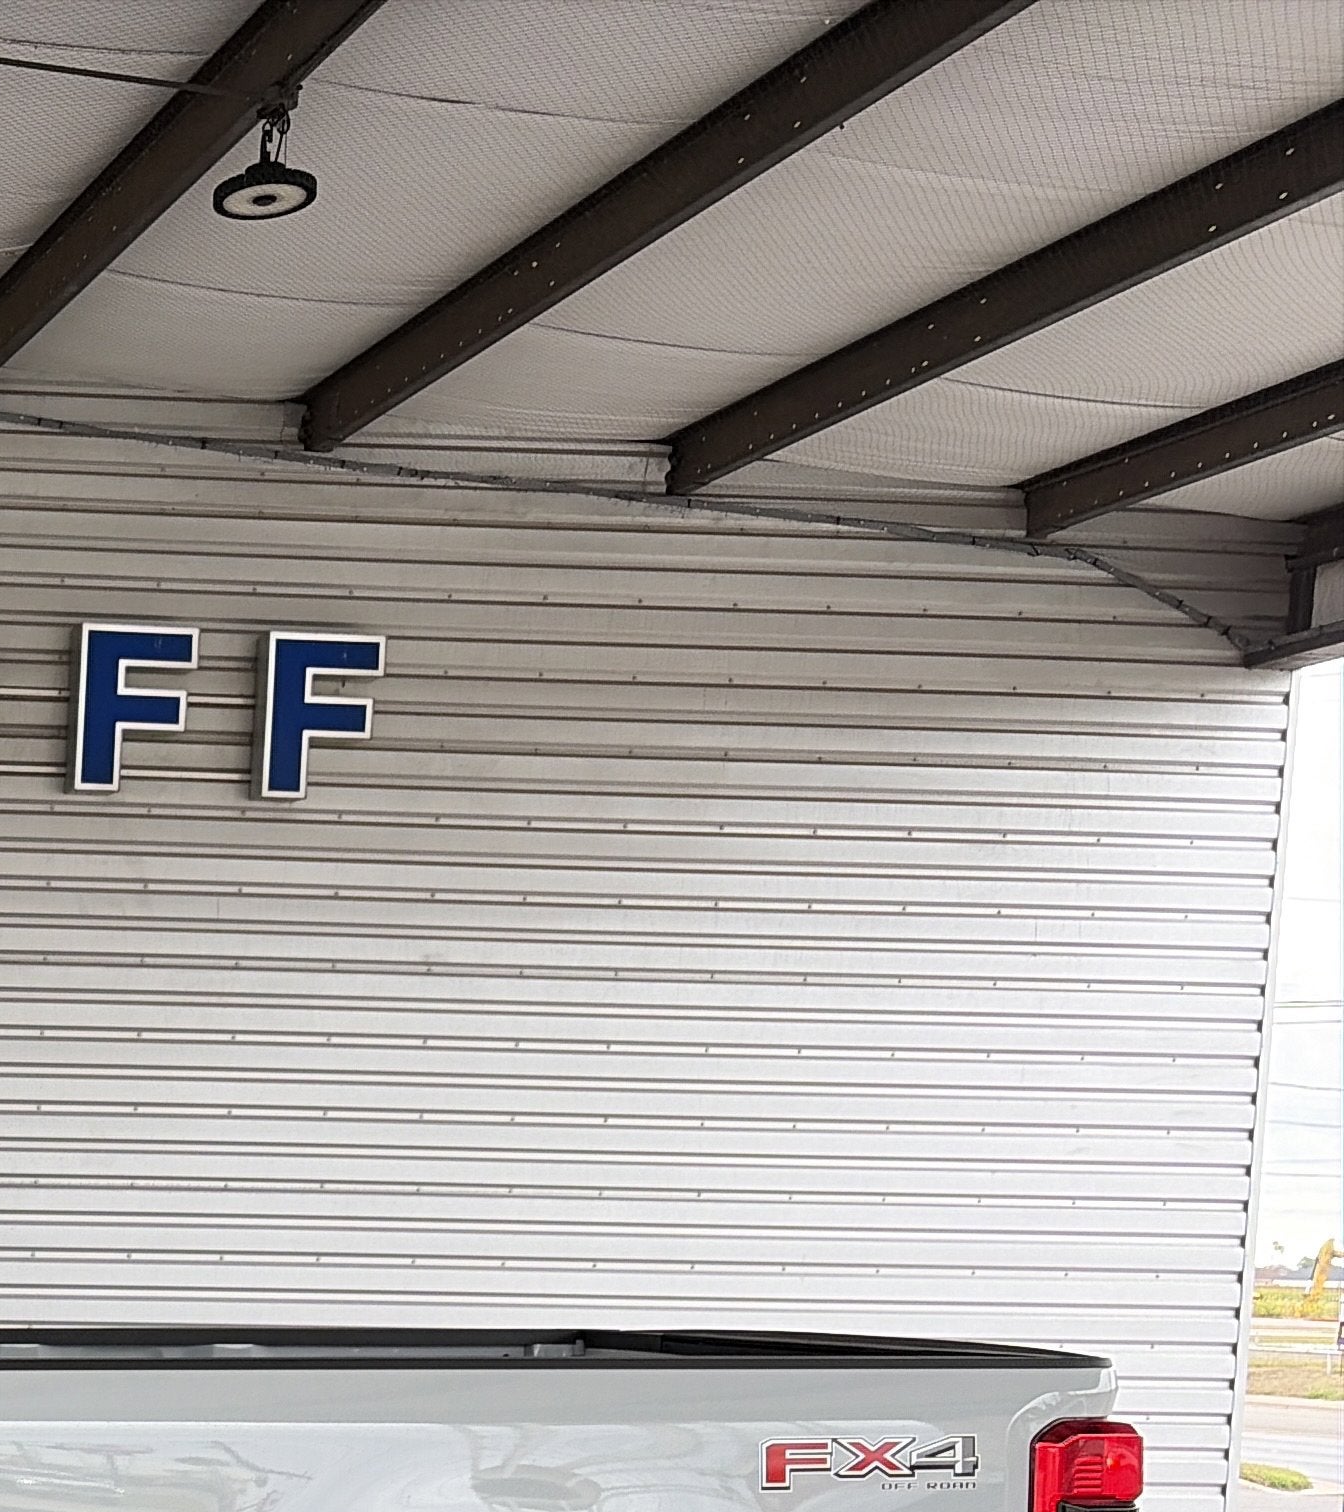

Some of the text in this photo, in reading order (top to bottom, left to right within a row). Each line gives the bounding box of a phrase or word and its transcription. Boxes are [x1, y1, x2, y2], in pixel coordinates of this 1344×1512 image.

[760, 1436, 979, 1490] FX4
[881, 1481, 977, 1490] OFF ROAD
